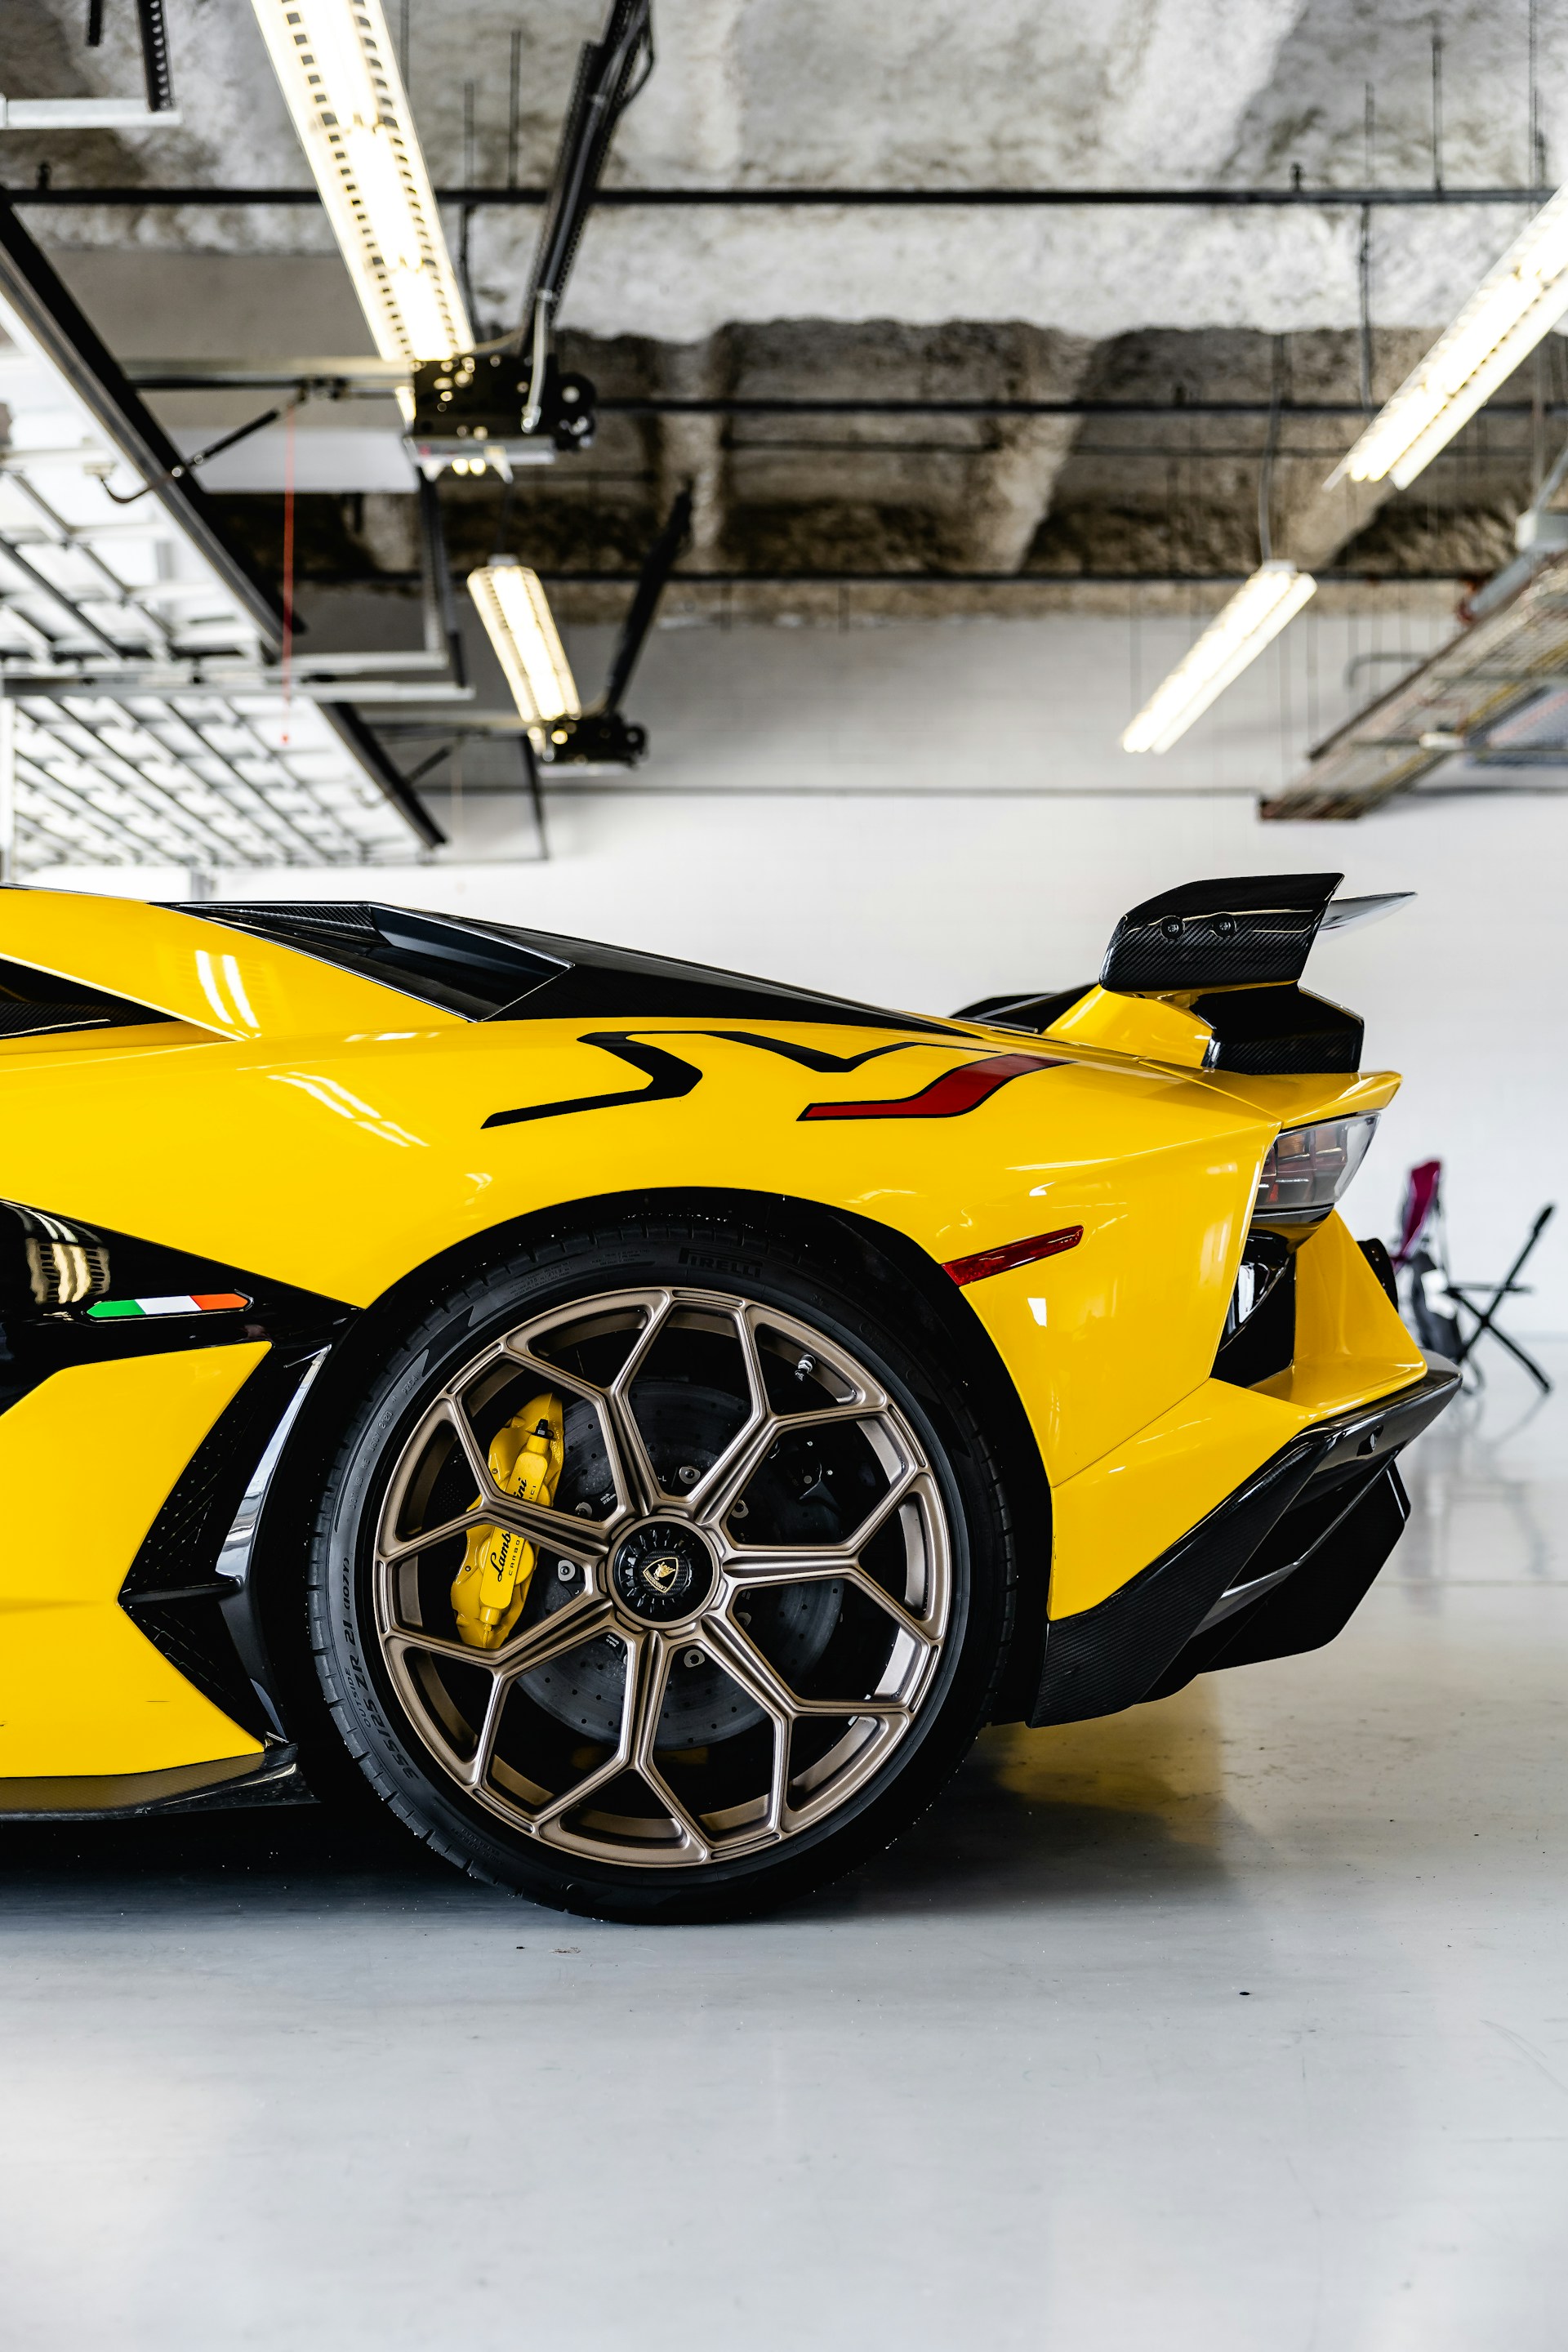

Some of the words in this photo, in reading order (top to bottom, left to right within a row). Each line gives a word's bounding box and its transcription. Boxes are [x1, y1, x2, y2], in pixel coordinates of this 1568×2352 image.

[678, 1247, 765, 1279] PIRELLI
[342, 1556, 351, 1610] (107Y)
[343, 1619, 356, 1646] 21
[350, 1654, 370, 1692] ZR
[345, 1668, 372, 1729] OUTSIDE
[364, 1696, 420, 1780] 355/25
